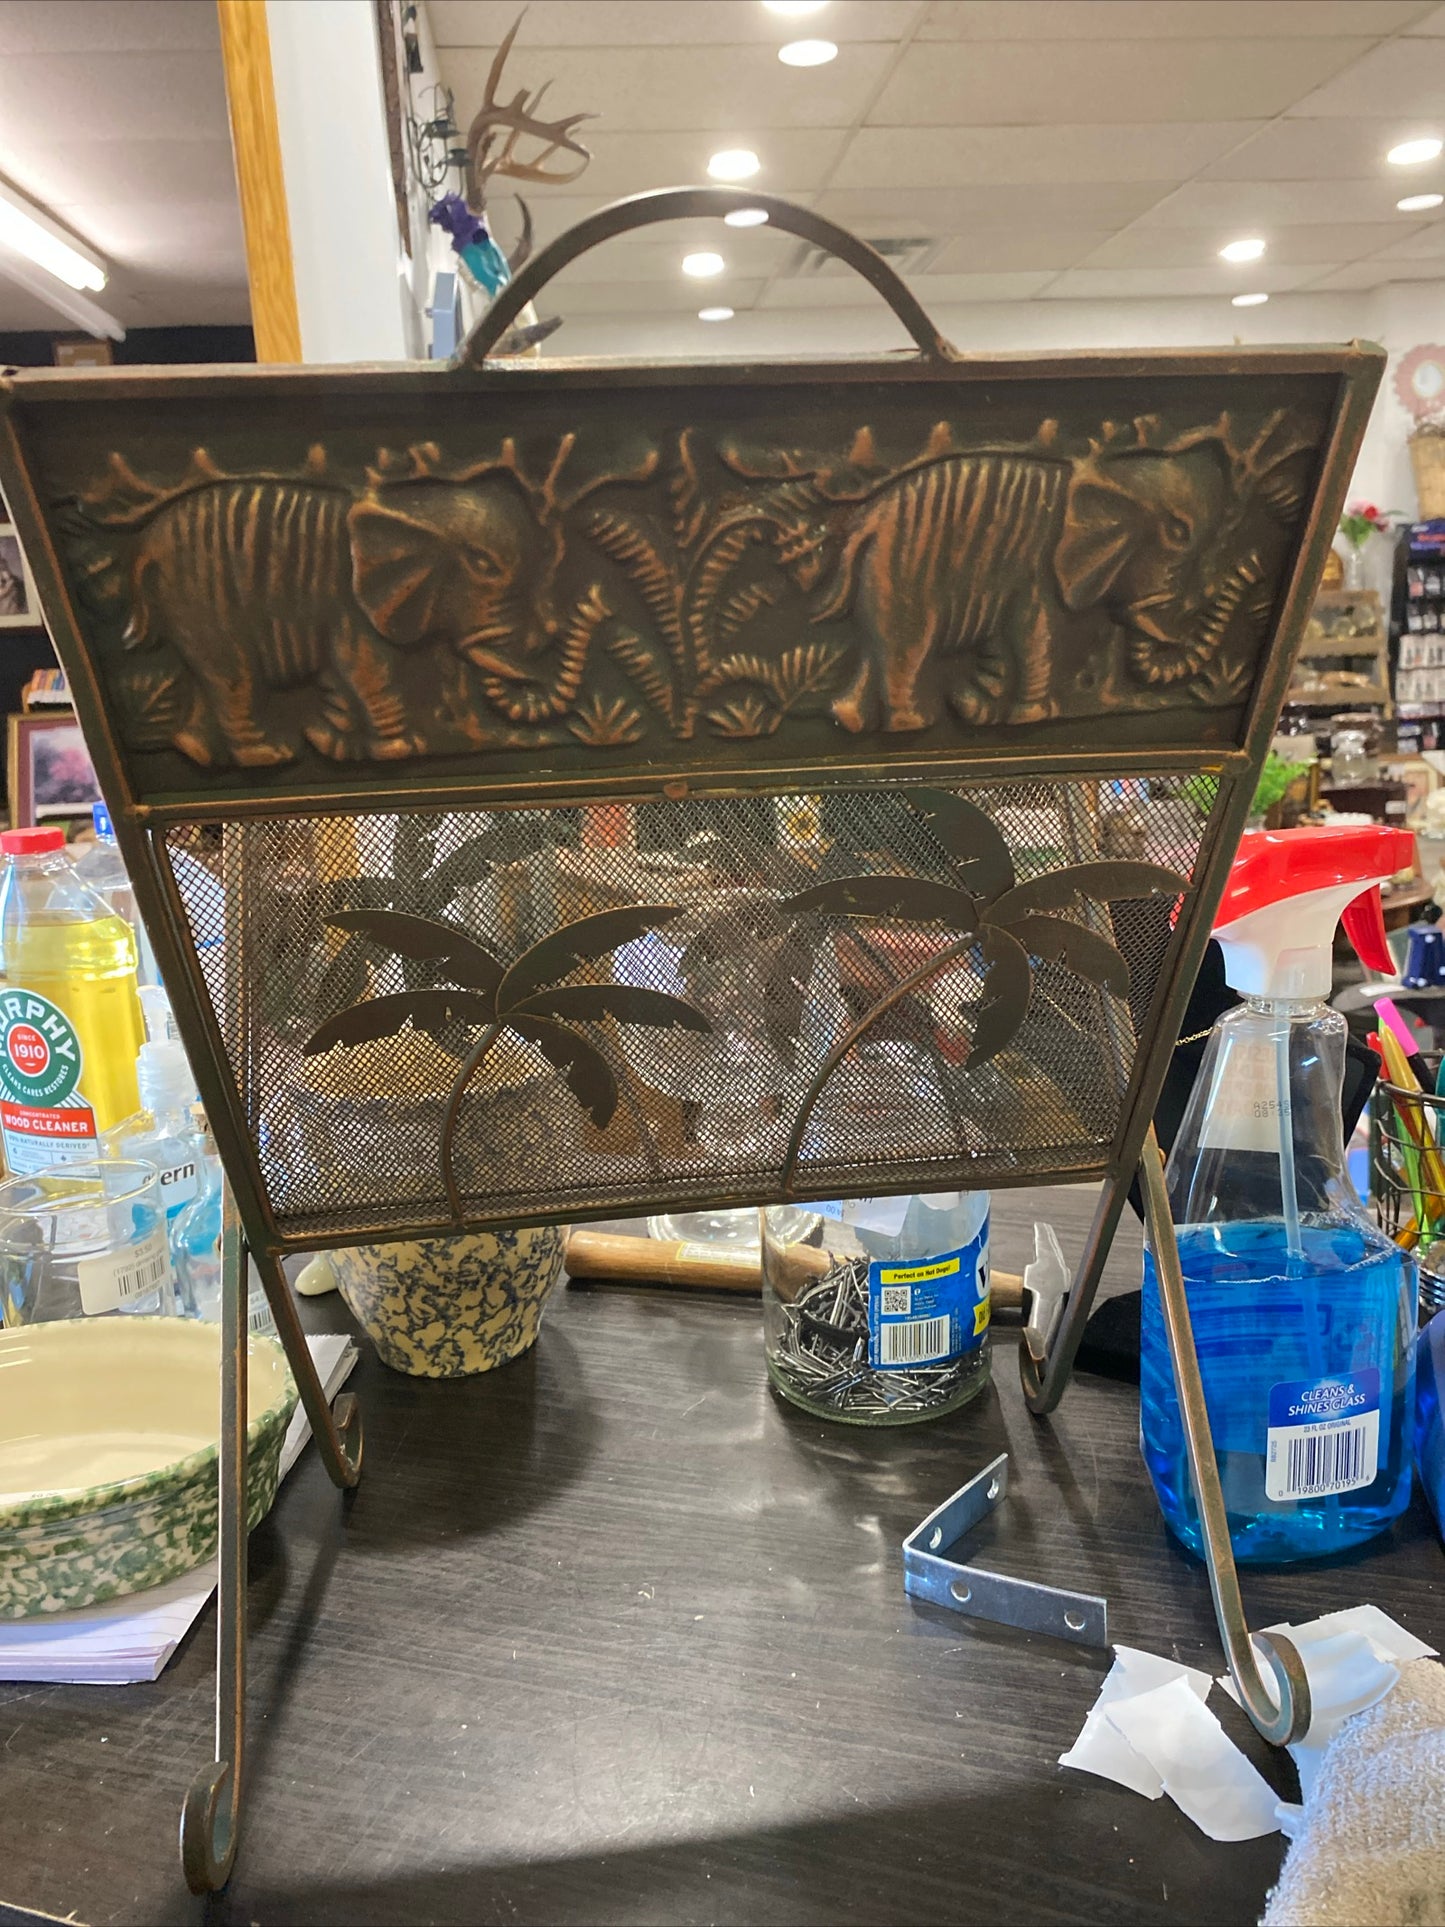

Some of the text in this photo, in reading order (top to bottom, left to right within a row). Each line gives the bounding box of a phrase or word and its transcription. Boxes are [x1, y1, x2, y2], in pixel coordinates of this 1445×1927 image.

[17, 1034, 36, 1042] SINCE
[14, 1044, 45, 1060] 1910
[2, 1063, 69, 1097] CLEANS CARES RESTORES
[4, 1113, 88, 1133] WOOD CLEANER
[20, 1137, 53, 1149] NATURALLY
[893, 1271, 916, 1280] Perfect
[925, 1268, 936, 1277] Hot
[1301, 1383, 1355, 1402] CLEANS &
[1288, 1393, 1366, 1417] SHINES GLASS
[1327, 1419, 1351, 1430] ORIGINAL
[1297, 1483, 1326, 1495] 19800
[1329, 1478, 1357, 1491] 70195
